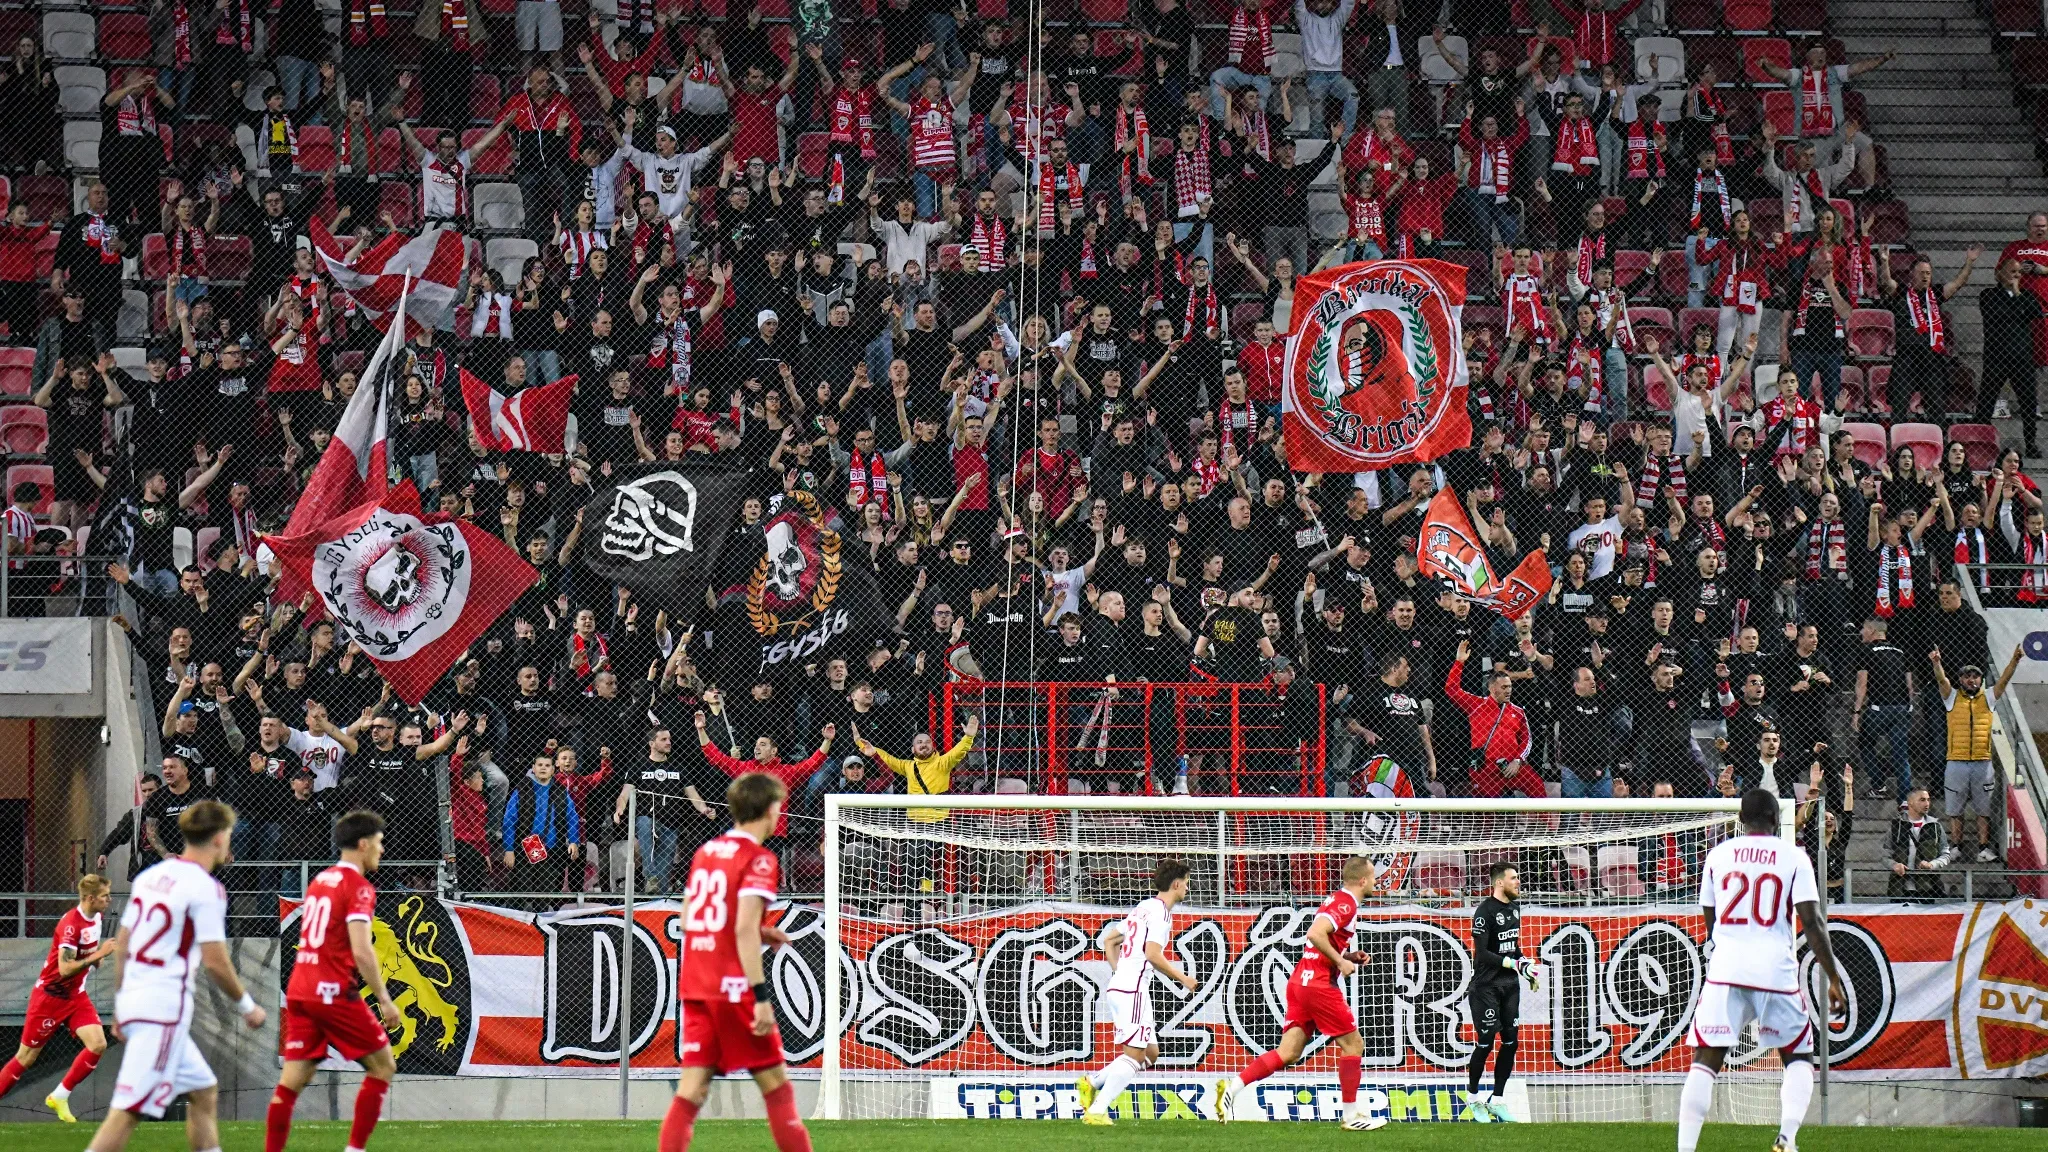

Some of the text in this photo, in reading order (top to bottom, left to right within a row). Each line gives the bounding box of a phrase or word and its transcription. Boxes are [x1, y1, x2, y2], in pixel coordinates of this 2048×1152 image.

[1733, 847, 1777, 866] YOUGA
[686, 867, 727, 933] 23
[1720, 870, 1783, 928] 20
[1140, 1025, 1151, 1042] 13
